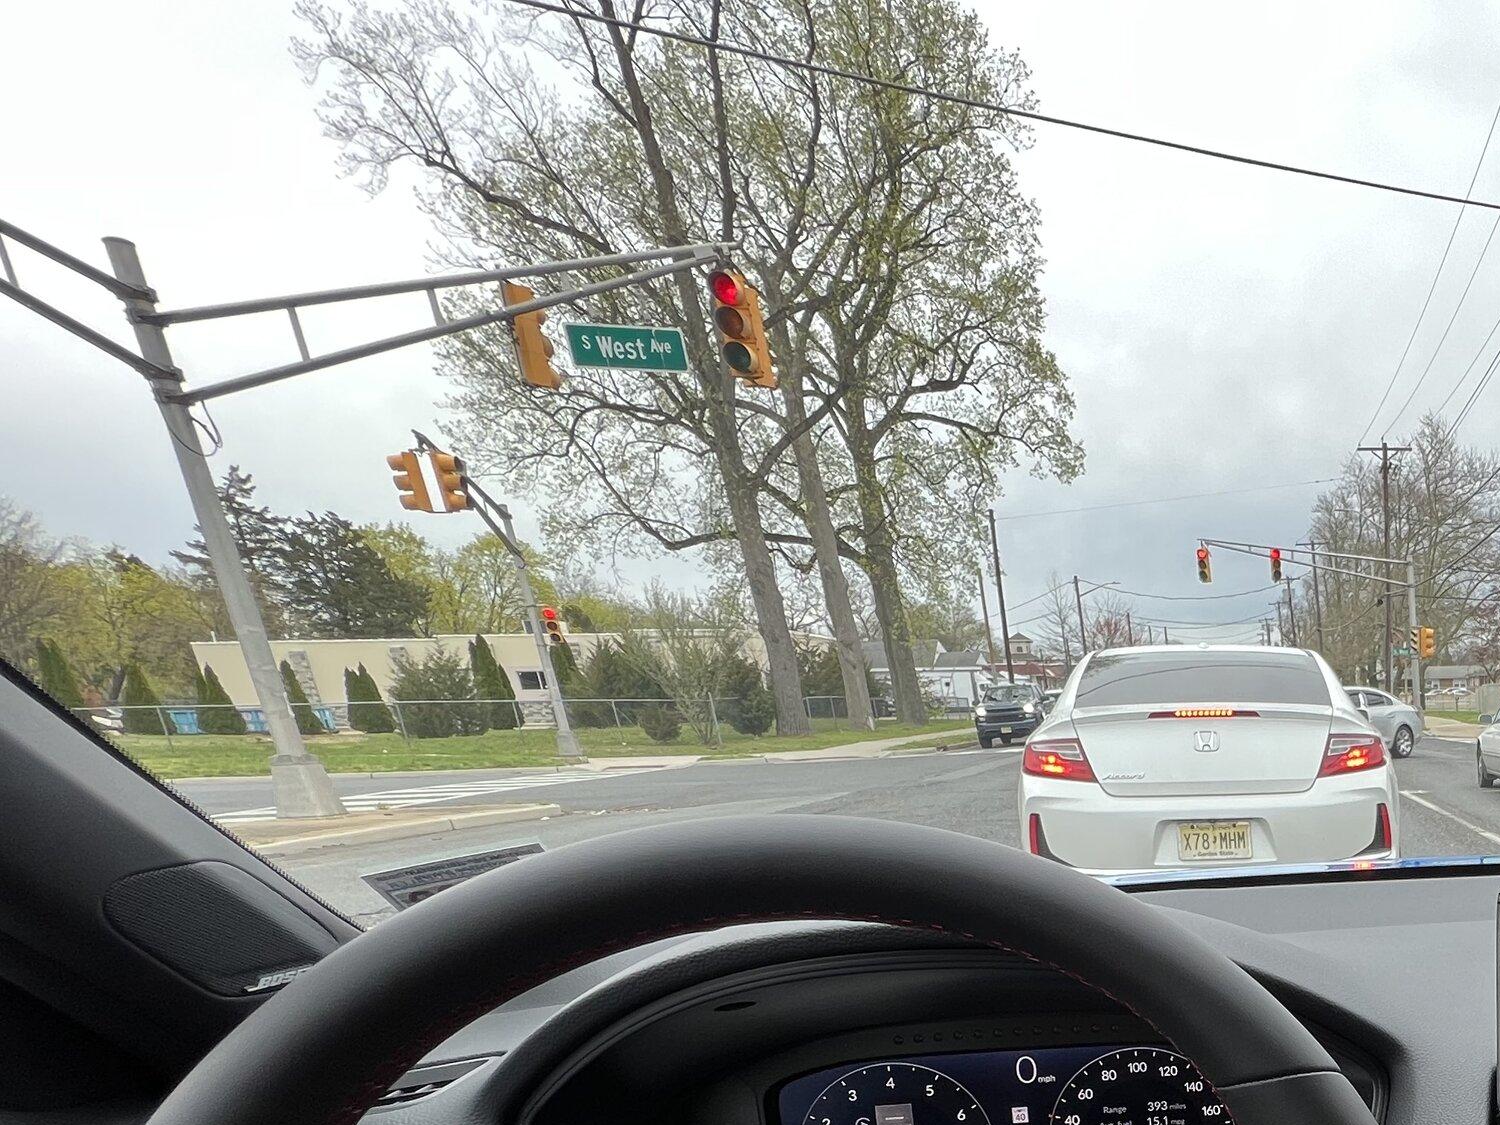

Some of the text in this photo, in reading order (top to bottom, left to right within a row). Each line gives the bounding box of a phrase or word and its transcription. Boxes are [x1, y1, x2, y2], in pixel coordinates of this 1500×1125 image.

[581, 334, 672, 360] S West Ave
[1184, 831, 1246, 851] X78 MHM
[1016, 1055, 1056, 1084] 0 mph
[1127, 1061, 1148, 1074] 100
[1158, 1066, 1179, 1077] 120
[1101, 1070, 1118, 1081] 80
[885, 1077, 895, 1090] 4
[1184, 1081, 1204, 1093] 140
[848, 1090, 857, 1102] 3
[925, 1085, 935, 1097] 5
[1077, 1088, 1094, 1101] 60
[1103, 1105, 1127, 1115] Range
[1147, 1101, 1168, 1112] 393
[1202, 1105, 1221, 1117] 160
[956, 1109, 966, 1121] 6
[1064, 1115, 1081, 1125] 40
